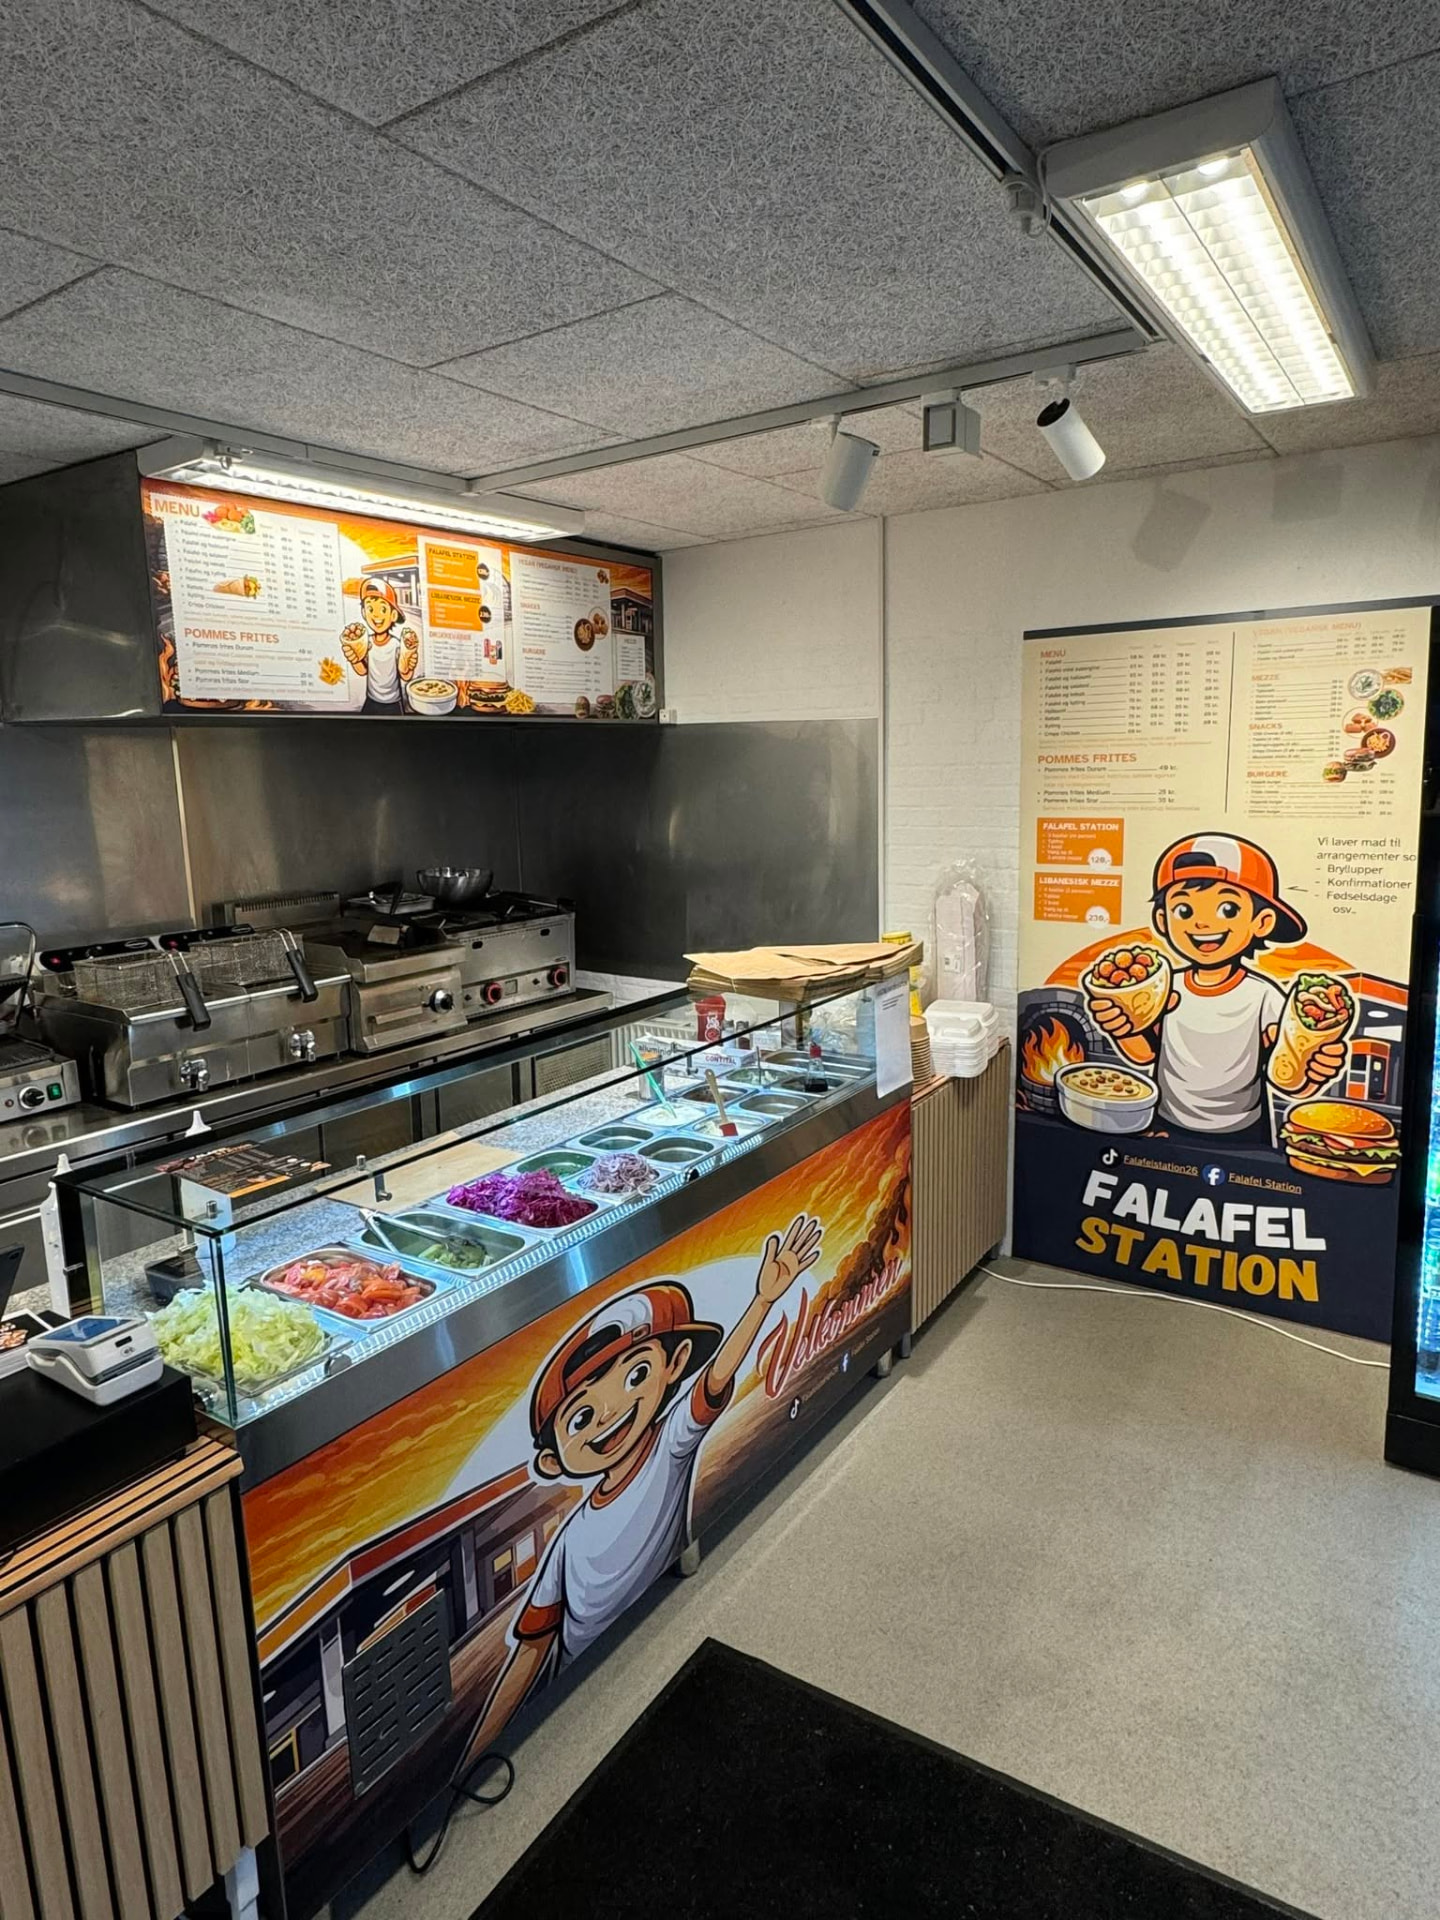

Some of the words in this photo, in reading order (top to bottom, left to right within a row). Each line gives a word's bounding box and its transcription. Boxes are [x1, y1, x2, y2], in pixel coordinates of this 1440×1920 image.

[154, 499, 200, 517] MENU
[184, 628, 236, 641] POMMES
[240, 632, 279, 643] FRITES
[1040, 649, 1066, 659] MENU
[1037, 754, 1089, 764] POMMES
[1093, 753, 1137, 763] FRITES
[1247, 770, 1288, 778] BURGERE
[1043, 823, 1077, 831] FALAFEL
[1080, 823, 1119, 831] STATION
[1317, 837, 1329, 846] Vi
[1332, 837, 1358, 846] laver
[1361, 837, 1387, 847] mad
[1390, 837, 1401, 848] til
[1317, 852, 1400, 862] arrangementer
[1403, 854, 1417, 862] so
[1327, 864, 1384, 875] Bryllupper
[1039, 877, 1088, 886] LIBANESISK
[1091, 879, 1120, 887] MEZZE
[1327, 878, 1413, 889] Konfirmationer
[1327, 891, 1398, 904] Fødselsdage
[1123, 1154, 1199, 1177] Falafelstation26
[1228, 1172, 1262, 1187] Falafel
[1264, 1178, 1303, 1195] Station
[1081, 1169, 1327, 1251] FALAFEL
[1075, 1216, 1319, 1302] STATION
